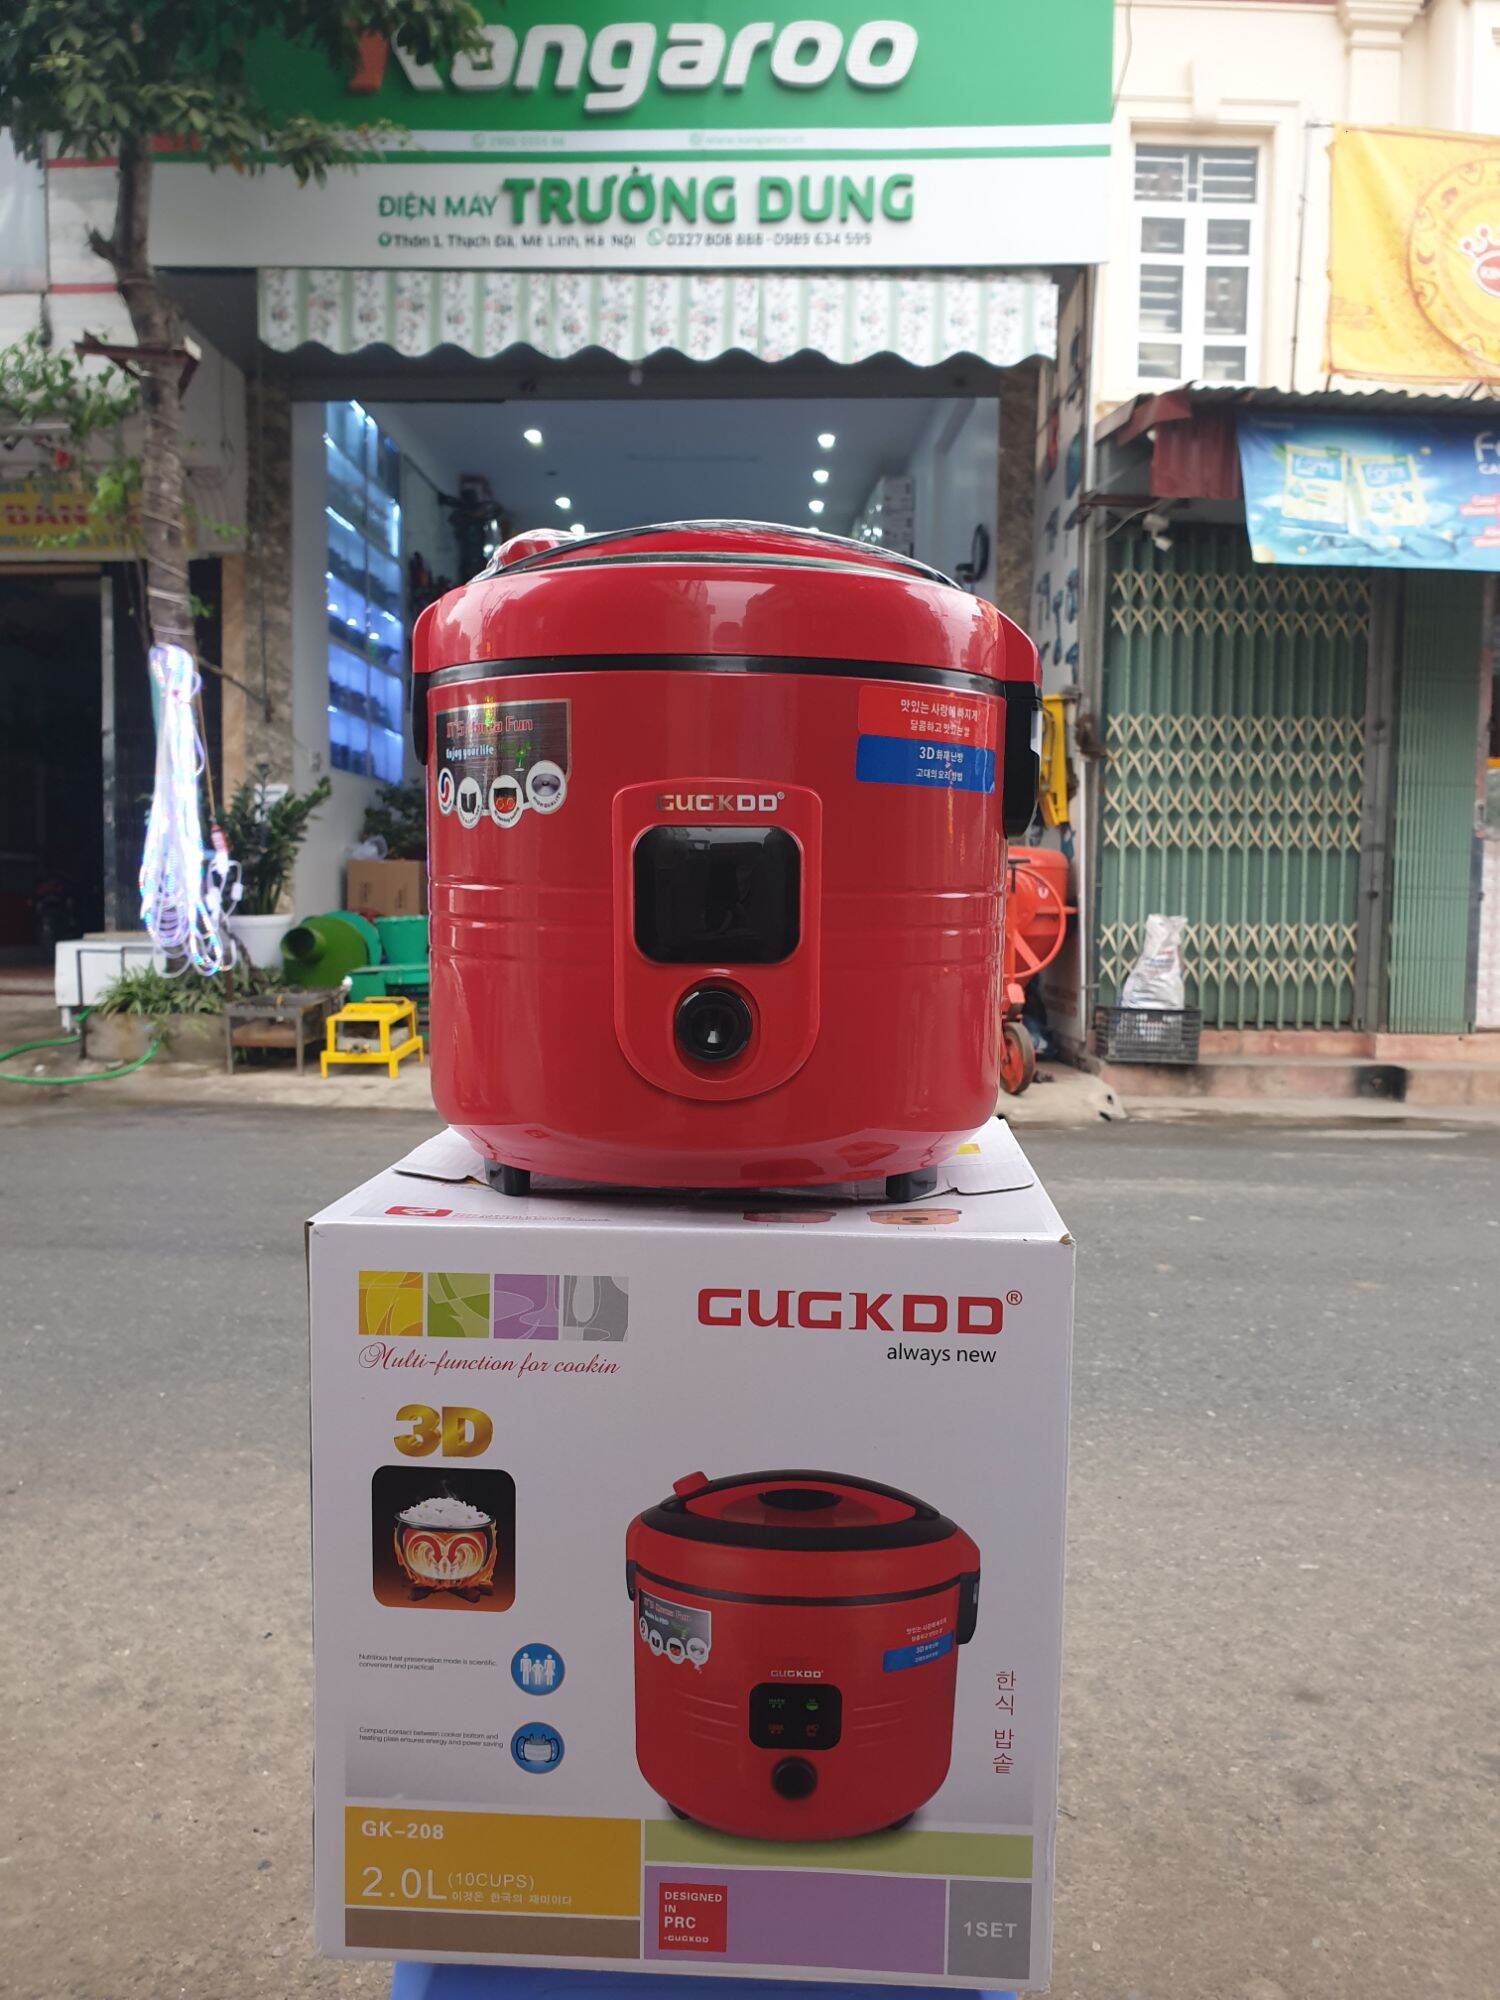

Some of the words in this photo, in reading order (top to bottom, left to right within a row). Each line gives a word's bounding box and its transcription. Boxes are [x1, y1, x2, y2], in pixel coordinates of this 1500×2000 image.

[758, 173, 915, 224] DUNG
[900, 699, 930, 715] 맛있는
[505, 715, 534, 732] Fun
[480, 743, 494, 756] life
[919, 746, 935, 760] 3D
[886, 1343, 950, 1365] always
[956, 1348, 997, 1363] new
[518, 1351, 550, 1379] for
[553, 1353, 620, 1376] cookin
[393, 1404, 494, 1458] 3D
[995, 1670, 1016, 1716] 한식
[359, 1727, 388, 1735] Compact
[361, 1820, 445, 1840] GK-208
[361, 1866, 448, 1900] 2.0L
[448, 1871, 535, 1891] (10CUPS)
[664, 1891, 723, 1903] DESIGNED
[664, 1904, 677, 1914] IN
[664, 1916, 697, 1930] PRC
[963, 1921, 1018, 1939] 1SET
